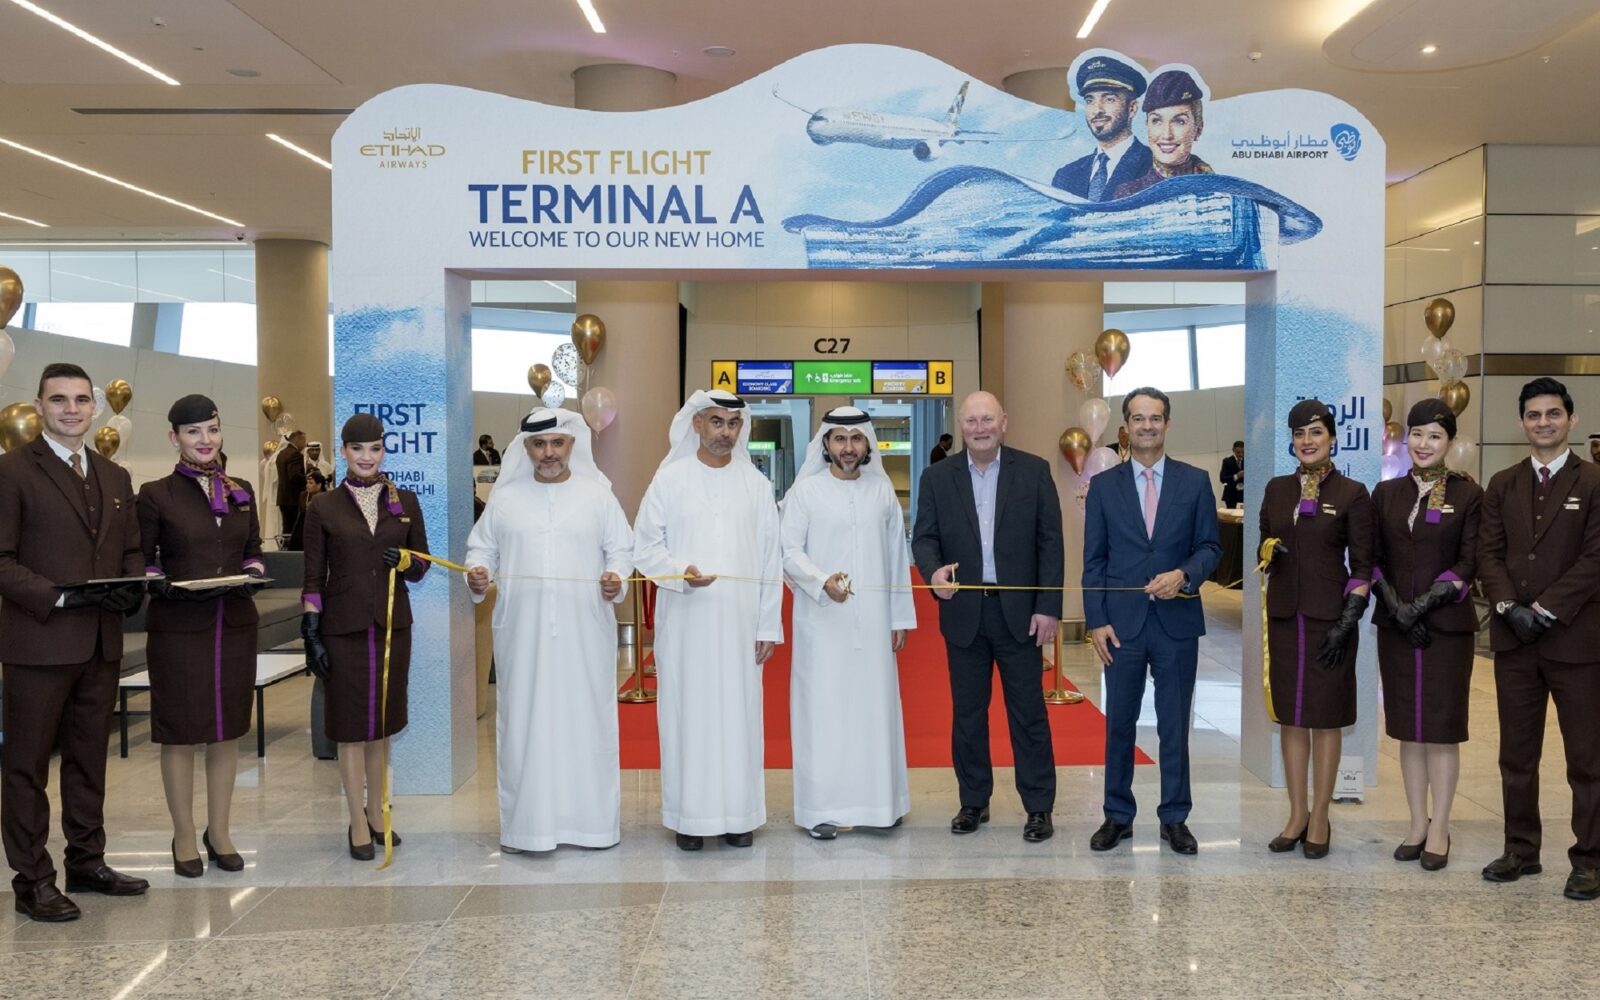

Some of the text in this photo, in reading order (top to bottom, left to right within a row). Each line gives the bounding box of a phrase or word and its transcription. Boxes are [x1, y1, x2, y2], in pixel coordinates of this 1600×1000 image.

[1294, 134, 1329, 150] مطار
[360, 145, 446, 157] ETIHAD
[1231, 151, 1329, 159] ABU DHABI AIRPORT
[379, 160, 427, 169] AIRWAYS
[522, 149, 711, 175] FIRST FLIGHT
[468, 184, 765, 224] TERMINAL A
[469, 230, 765, 248] WELCOME TO OUR NEW HOME
[813, 338, 851, 354] C27
[717, 371, 732, 385] A
[935, 371, 946, 385] B
[382, 432, 437, 453] GHT
